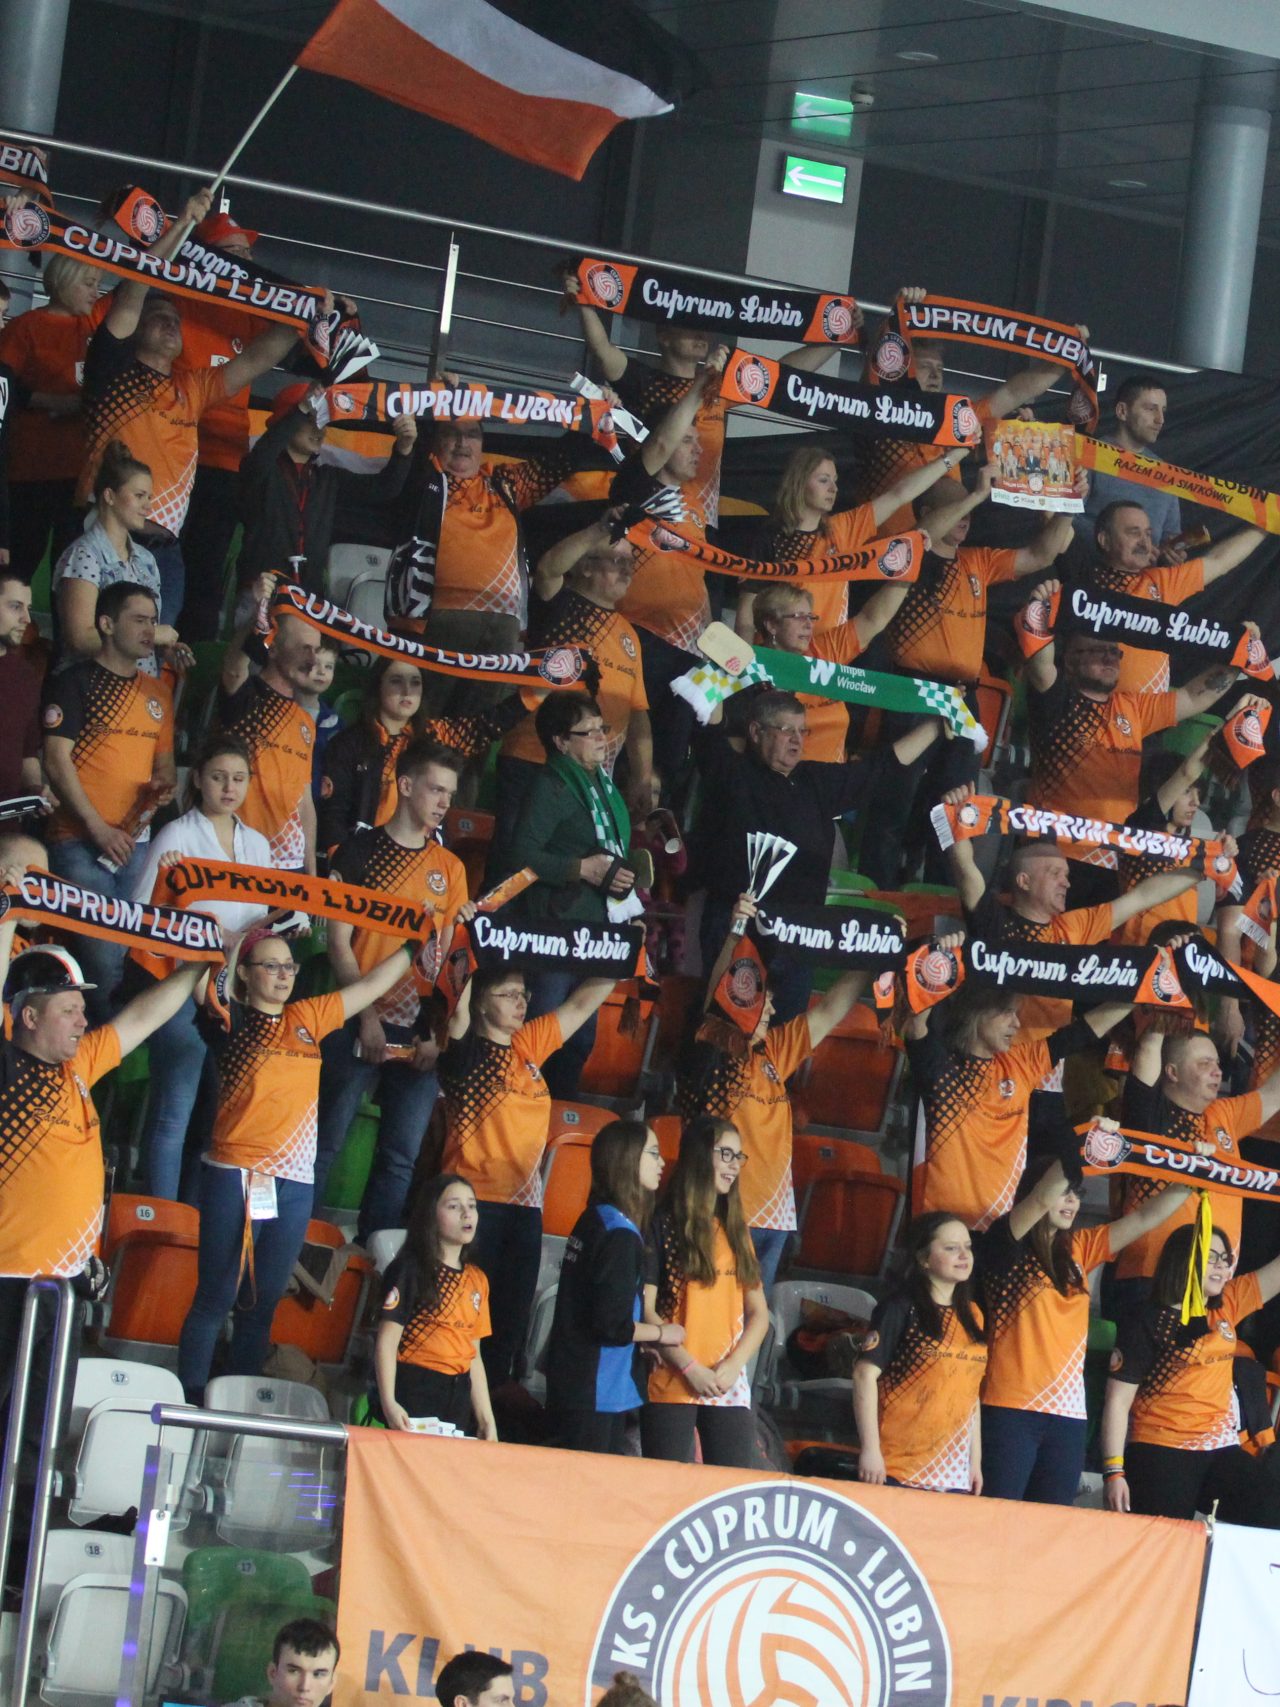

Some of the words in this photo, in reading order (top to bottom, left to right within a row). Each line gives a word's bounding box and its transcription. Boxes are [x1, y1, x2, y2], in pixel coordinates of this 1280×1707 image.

[0, 145, 48, 184] BIN
[63, 225, 217, 293] CUPRUM
[228, 277, 317, 319] LUBIN
[642, 278, 735, 319] Cuprum
[739, 295, 804, 327] Lubin
[1025, 331, 1094, 373] LUBIN
[386, 390, 493, 419] CUPRUM
[786, 374, 871, 416] Cuprum
[875, 395, 936, 429] Lubin
[1114, 458, 1153, 479] RAZEM
[1153, 471, 1175, 487] DLA
[1177, 478, 1233, 505] SIATKÓWKI
[287, 585, 426, 657] CUPRUM
[436, 649, 532, 673] LUBIN
[1072, 589, 1161, 633] Cuprum
[1165, 610, 1231, 650] Lubin
[836, 676, 877, 695] Wrocław
[1007, 806, 1114, 845] CUPRUM
[1118, 826, 1192, 860] LUBIN
[20, 876, 143, 933] CUPRUM
[167, 863, 310, 903] CUPRUM
[323, 889, 428, 932] LUBIN
[474, 915, 569, 960] Cuprum
[572, 927, 631, 961] Lubin
[755, 909, 835, 950] Cprum
[838, 919, 903, 954] Lubin
[971, 941, 1068, 985] Cuprum
[1071, 954, 1139, 987] Lubin
[1185, 943, 1239, 985] Cupr
[1144, 1144, 1278, 1192] CUPRUM
[139, 1208, 151, 1218] 16
[88, 1546, 100, 1555] 18
[610, 1603, 657, 1669] KS
[664, 1493, 839, 1580] CUPRUM
[857, 1545, 933, 1692] LUBIN
[364, 1629, 550, 1707] KLB
